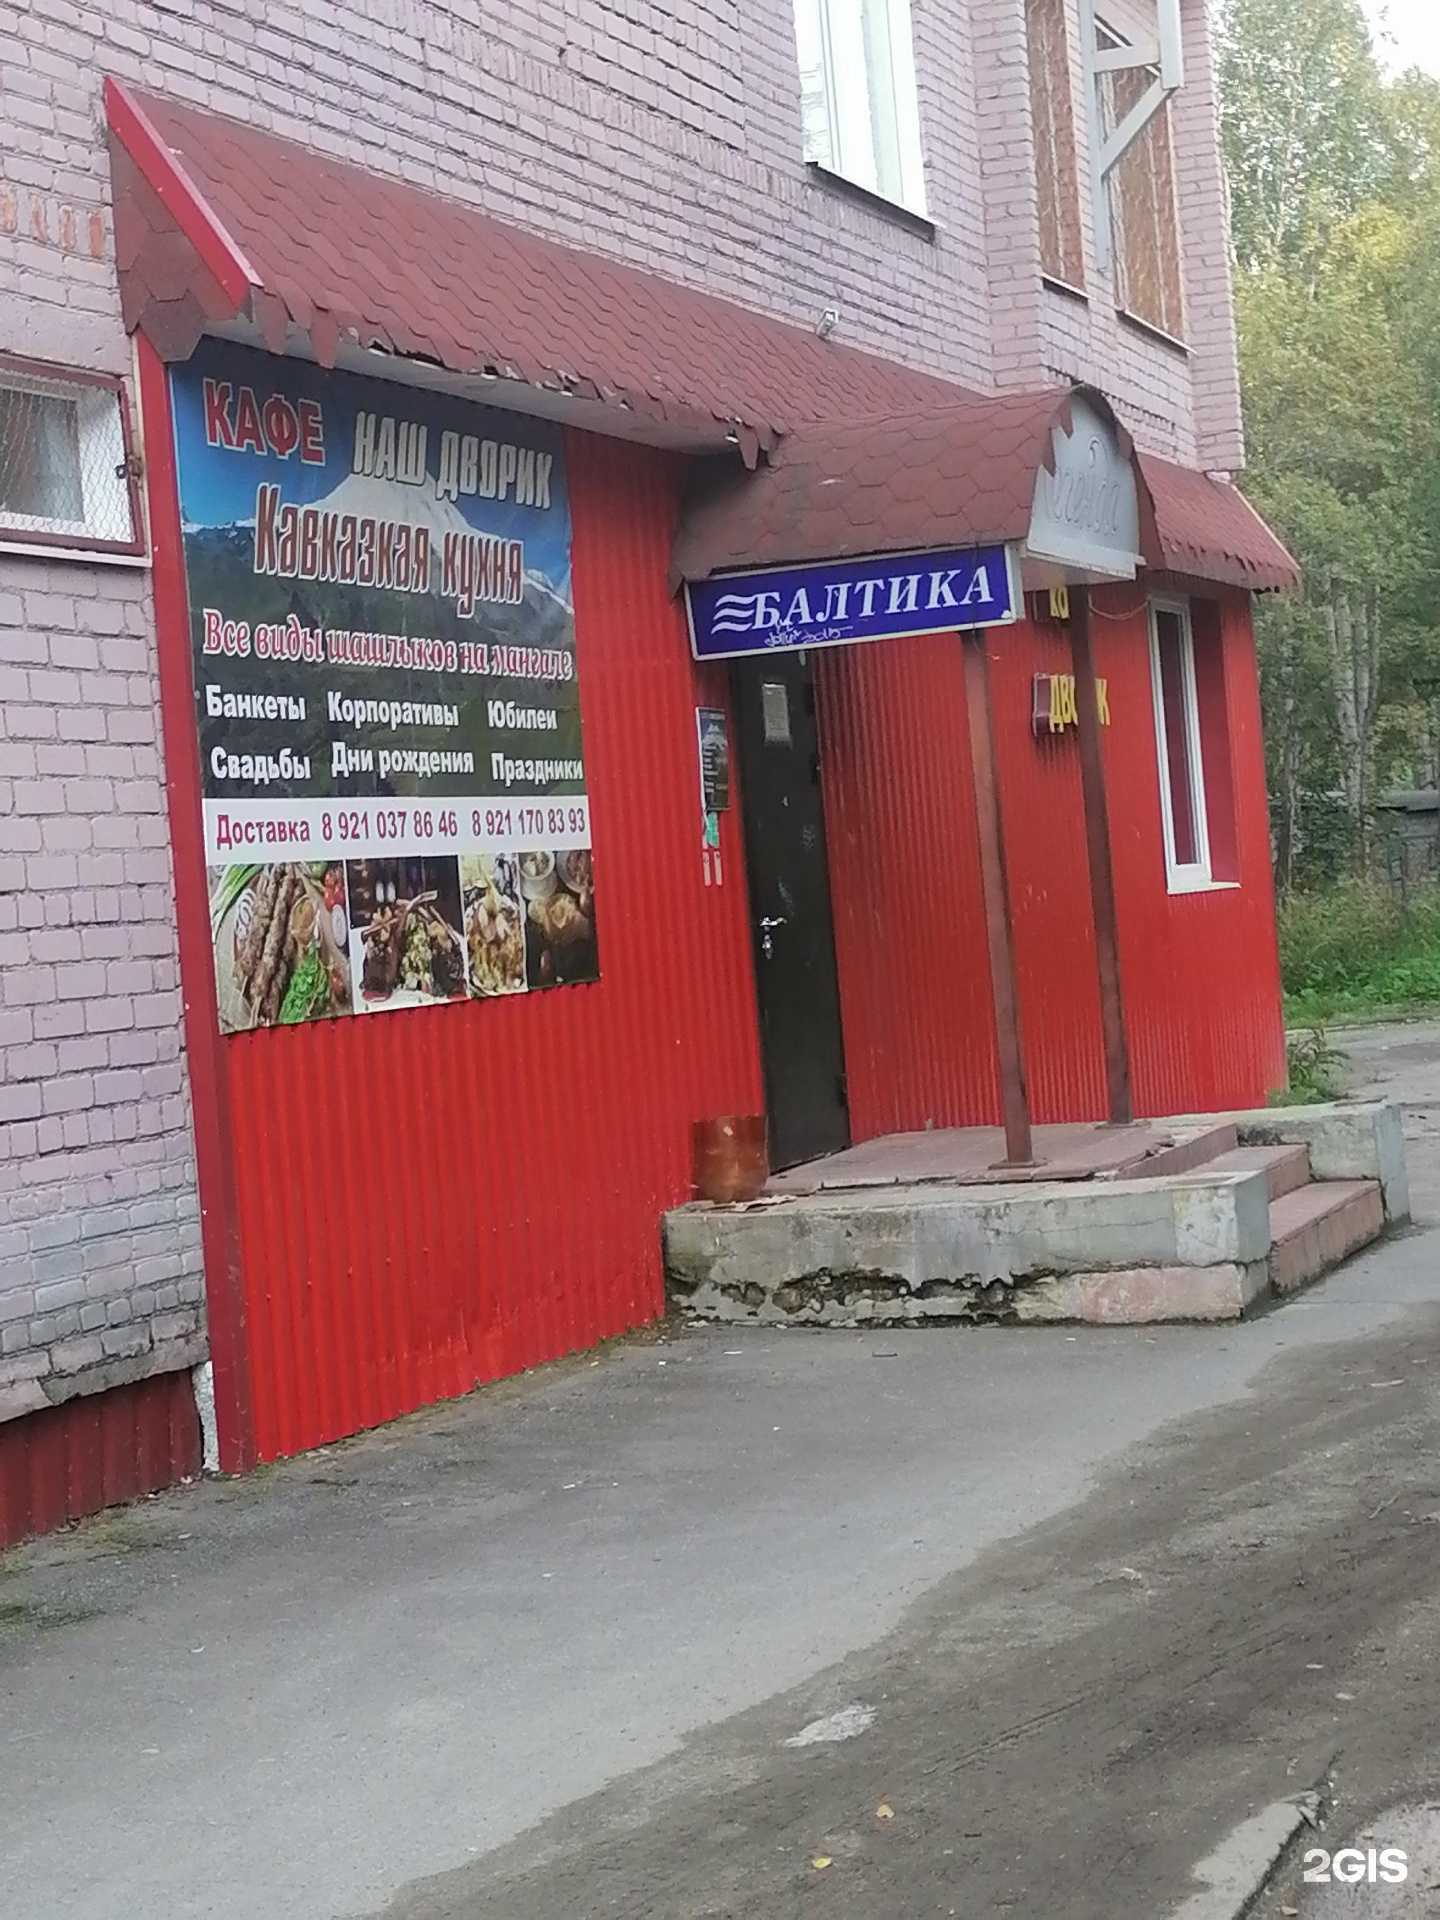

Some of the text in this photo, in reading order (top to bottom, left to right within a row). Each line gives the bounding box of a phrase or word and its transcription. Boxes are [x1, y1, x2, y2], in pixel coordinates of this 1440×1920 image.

[203, 377, 326, 467] КАФЕ
[353, 410, 553, 509] НАШ ДВОРИК
[254, 482, 524, 618] Кавказкая кухня
[751, 565, 995, 630] БАЛТИКА
[203, 608, 573, 681] Все виды шашлыков на мангале
[205, 684, 558, 730] Банкеты Корпоративы Юбилеи
[210, 741, 584, 787] Свадьбы Дни рождения Праздники
[216, 807, 586, 850] Доставка 8 921 037 86 46 8 921 170 83 93
